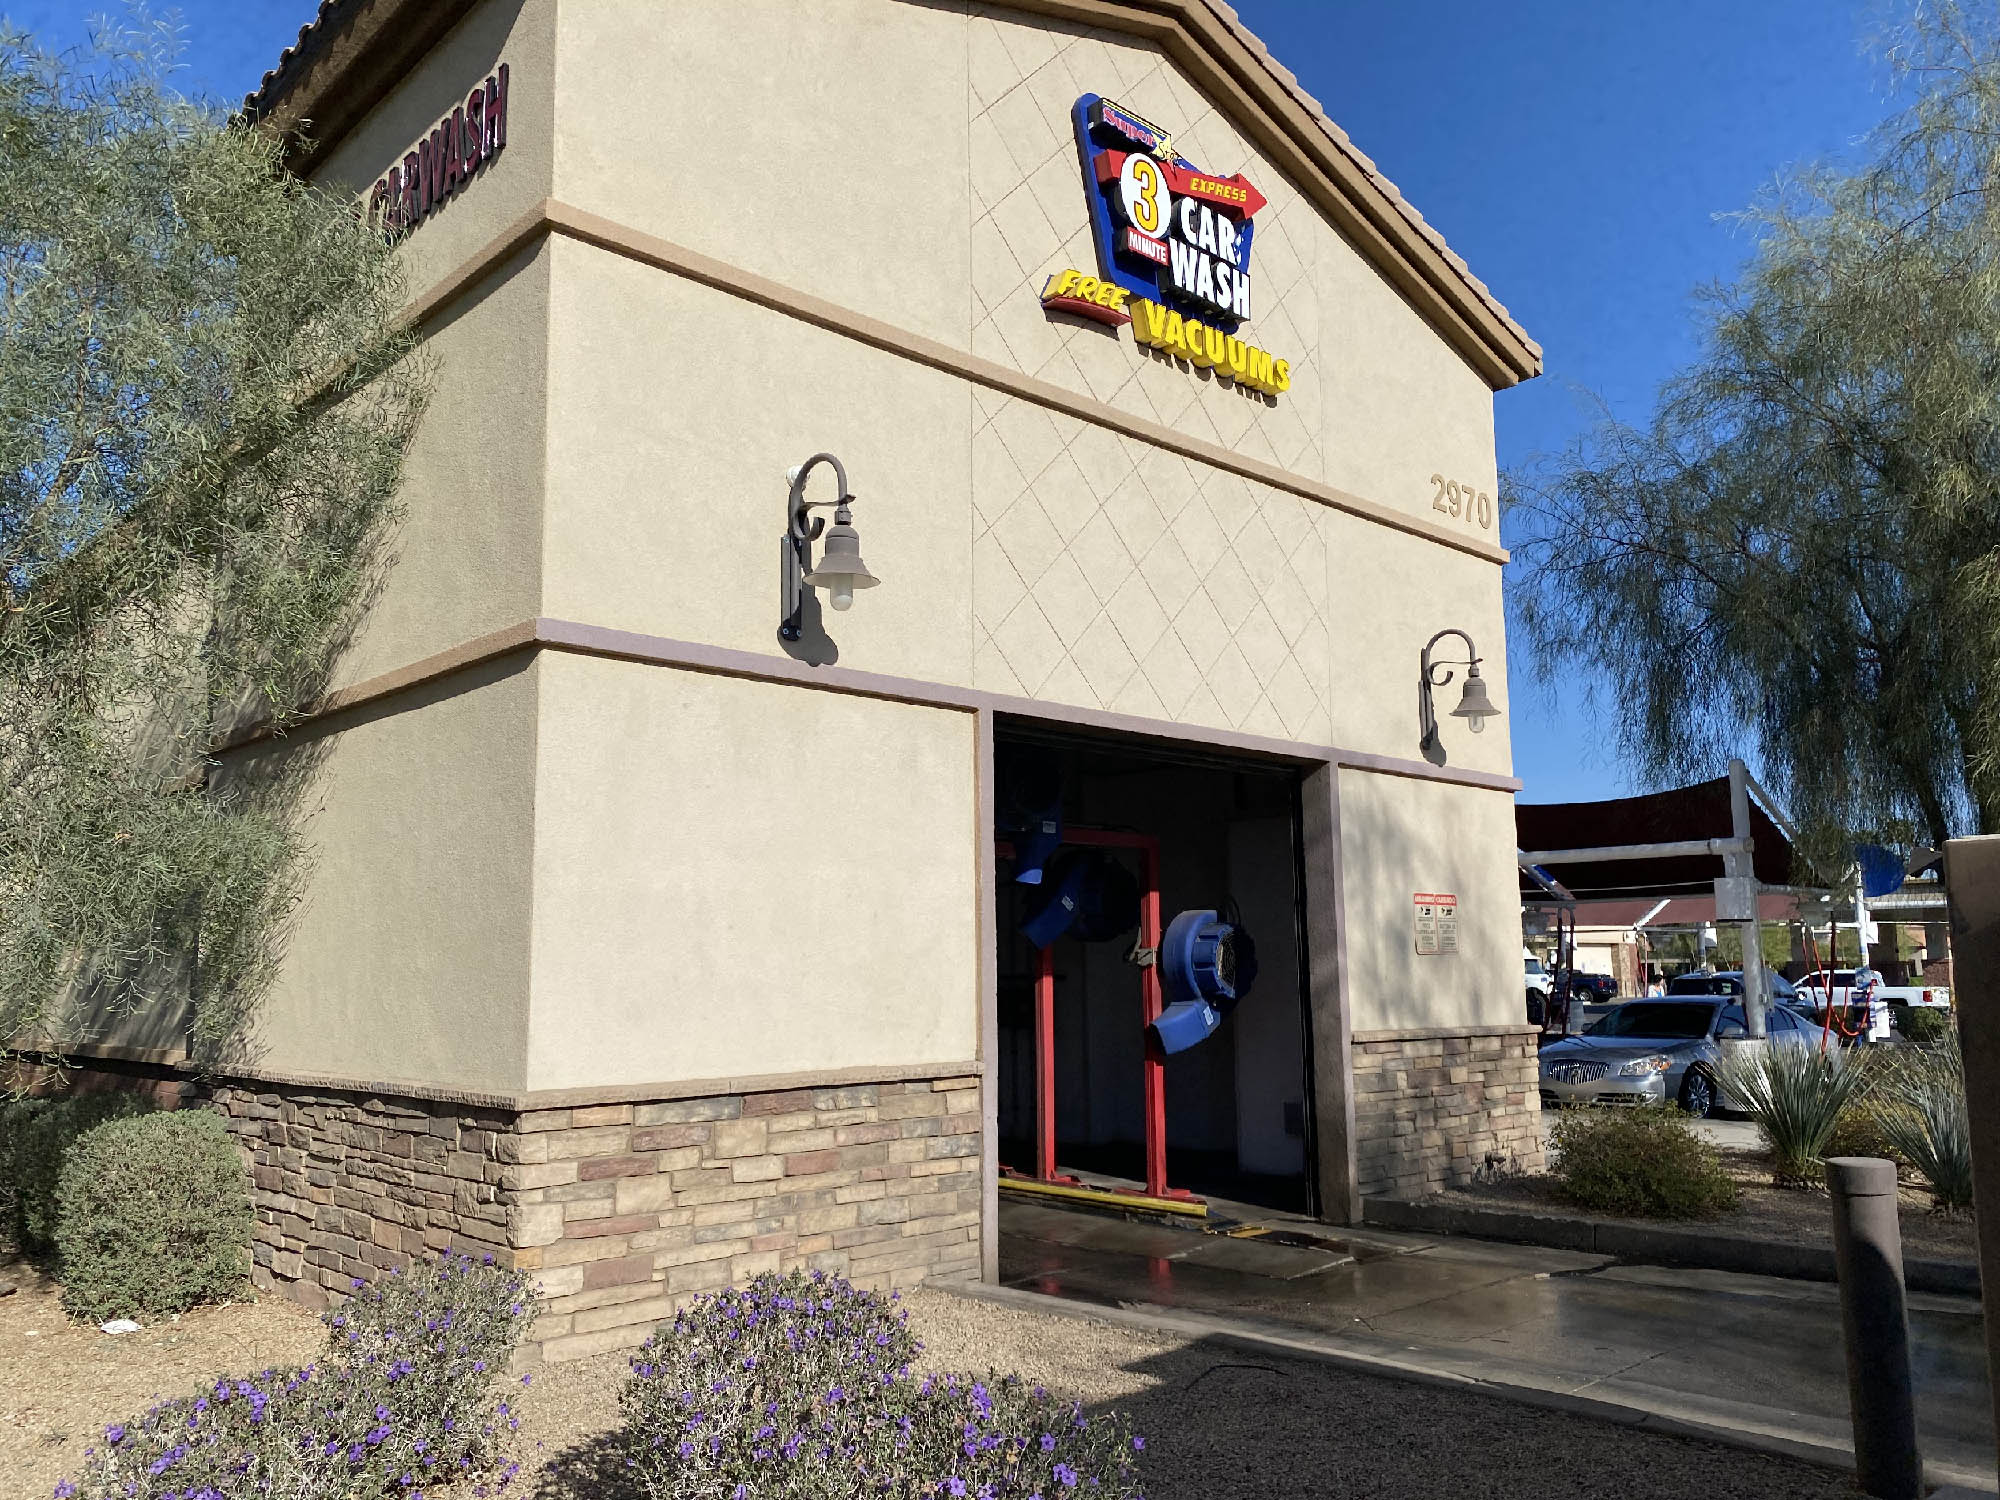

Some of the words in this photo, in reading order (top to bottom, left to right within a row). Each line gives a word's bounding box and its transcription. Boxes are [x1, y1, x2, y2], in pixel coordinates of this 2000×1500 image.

[1102, 106, 1156, 147] Super
[1133, 159, 1159, 233] 3
[1190, 177, 1248, 202] EXPRESS
[1129, 230, 1167, 262] MINUTE
[1180, 196, 1238, 265] CAR
[1168, 236, 1250, 320] WASH
[1055, 269, 1131, 311] FREE
[1142, 298, 1291, 393] VACUUMS
[1431, 473, 1491, 530] 2970
